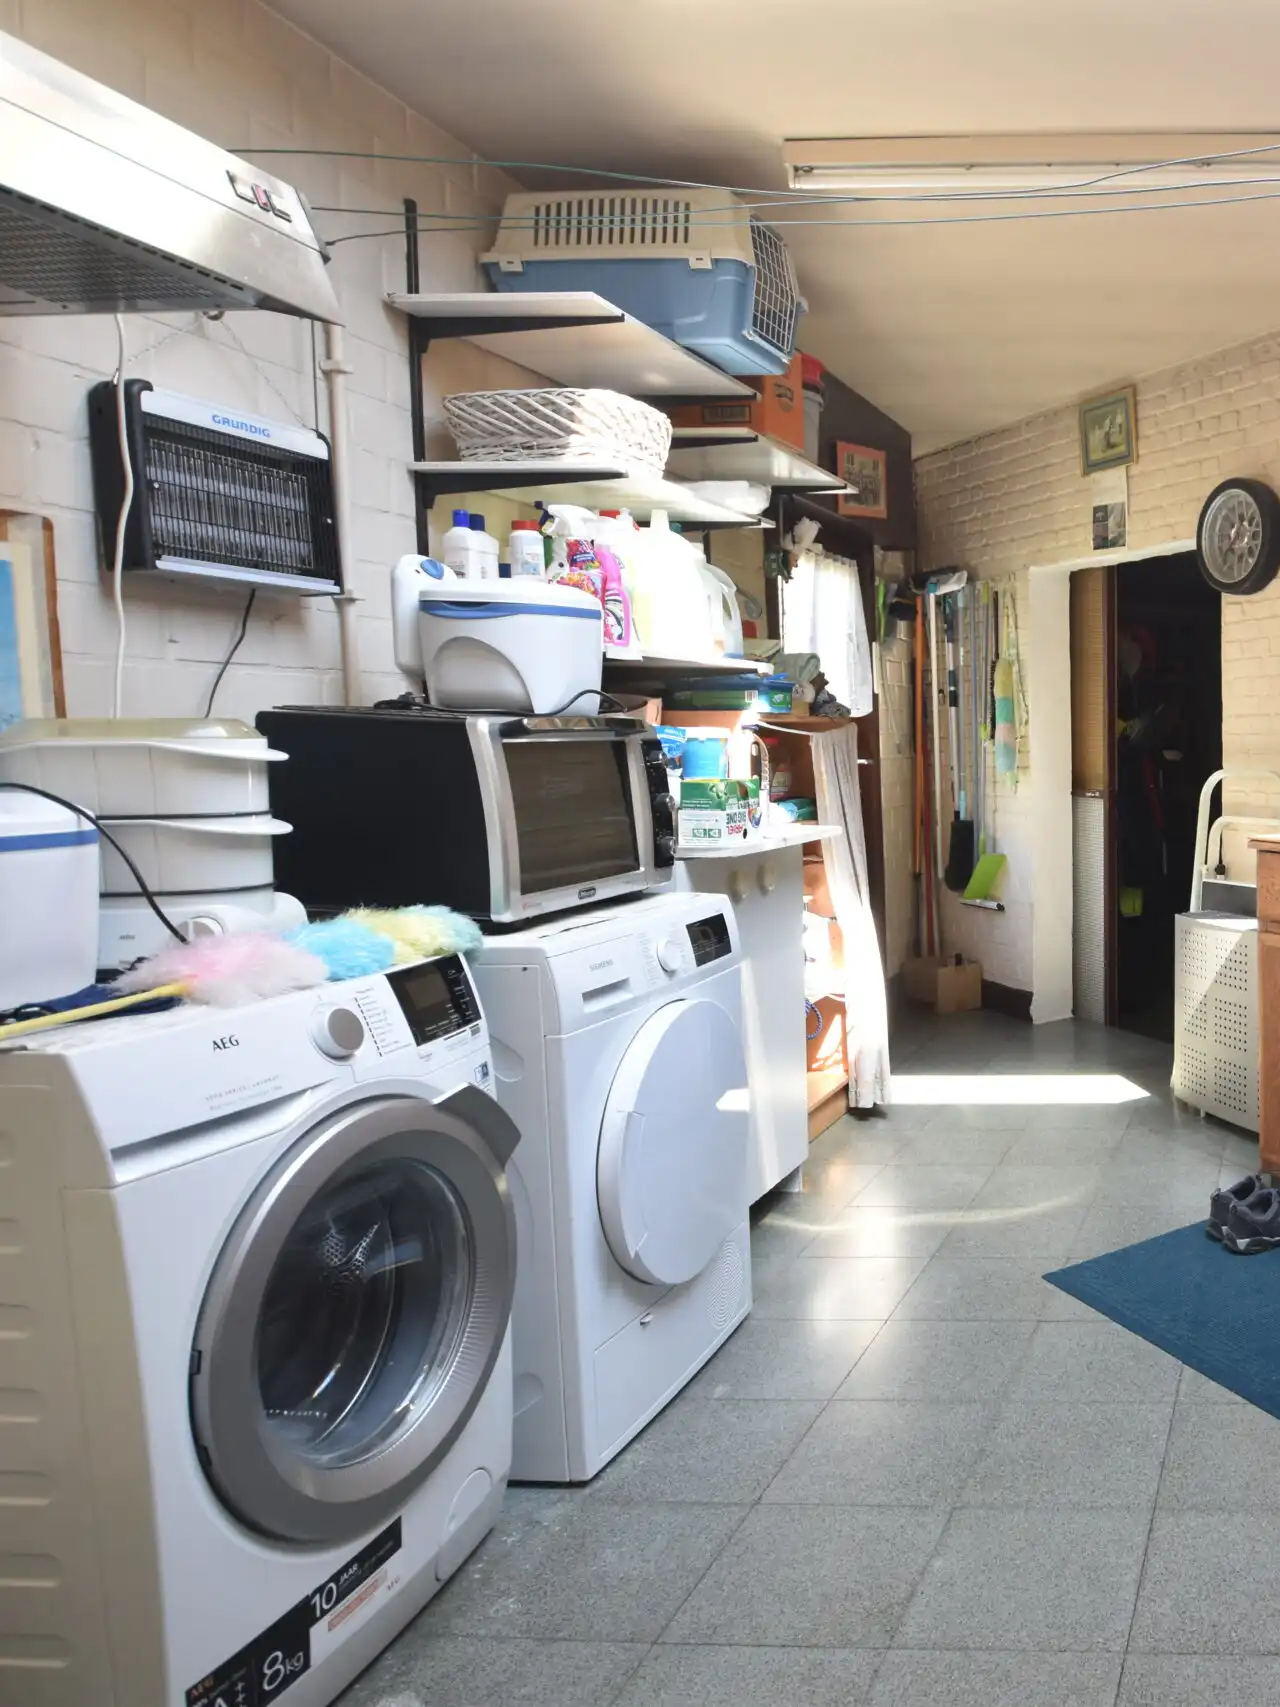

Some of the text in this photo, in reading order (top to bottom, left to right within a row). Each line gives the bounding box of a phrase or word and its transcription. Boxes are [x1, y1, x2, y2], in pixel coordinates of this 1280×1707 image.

[211, 414, 271, 438] GRUNDIG
[212, 1034, 240, 1052] AEG
[310, 1562, 359, 1619] 10 JAAR
